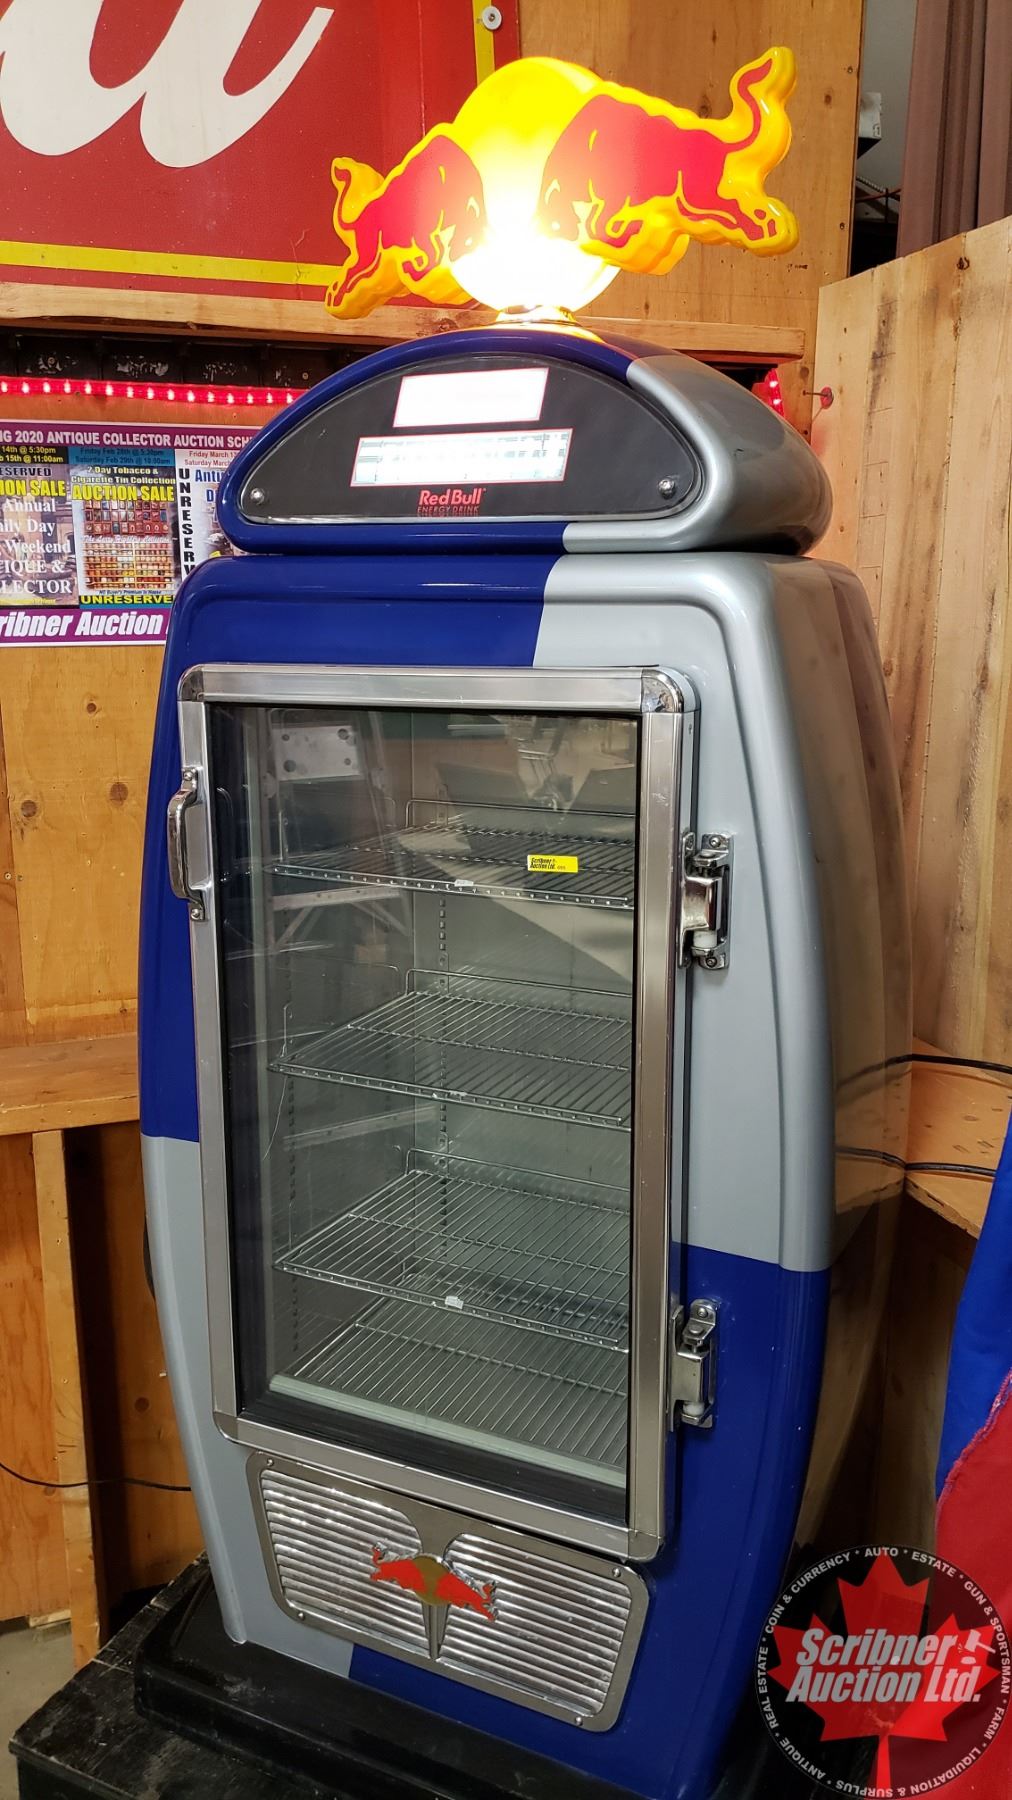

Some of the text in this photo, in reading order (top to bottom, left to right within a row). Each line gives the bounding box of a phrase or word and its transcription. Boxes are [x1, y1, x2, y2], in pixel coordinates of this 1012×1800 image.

[15, 430, 44, 443] 2020
[46, 431, 100, 445] ANTIQUE
[102, 433, 171, 447] COLLECTOR
[173, 434, 225, 448] AUCTION
[2, 446, 18, 454] 14th
[28, 446, 56, 455] 5:30pm
[189, 451, 209, 459] Friday
[210, 451, 229, 459] March
[5, 455, 22, 463] 15th
[33, 455, 64, 463] 11:00am
[185, 459, 212, 467] Saturday
[94, 466, 112, 476] Day
[113, 466, 151, 475] Tobacco
[30, 479, 66, 497] SALE
[70, 476, 176, 486] Cigarette Tin Collection
[71, 485, 175, 502] AUCTION SALE
[418, 488, 451, 506] Red
[2, 498, 57, 513] Annual
[26, 518, 56, 537] Day
[4, 539, 72, 553] Weekend
[51, 560, 65, 574] &
[75, 611, 164, 636] Auction
